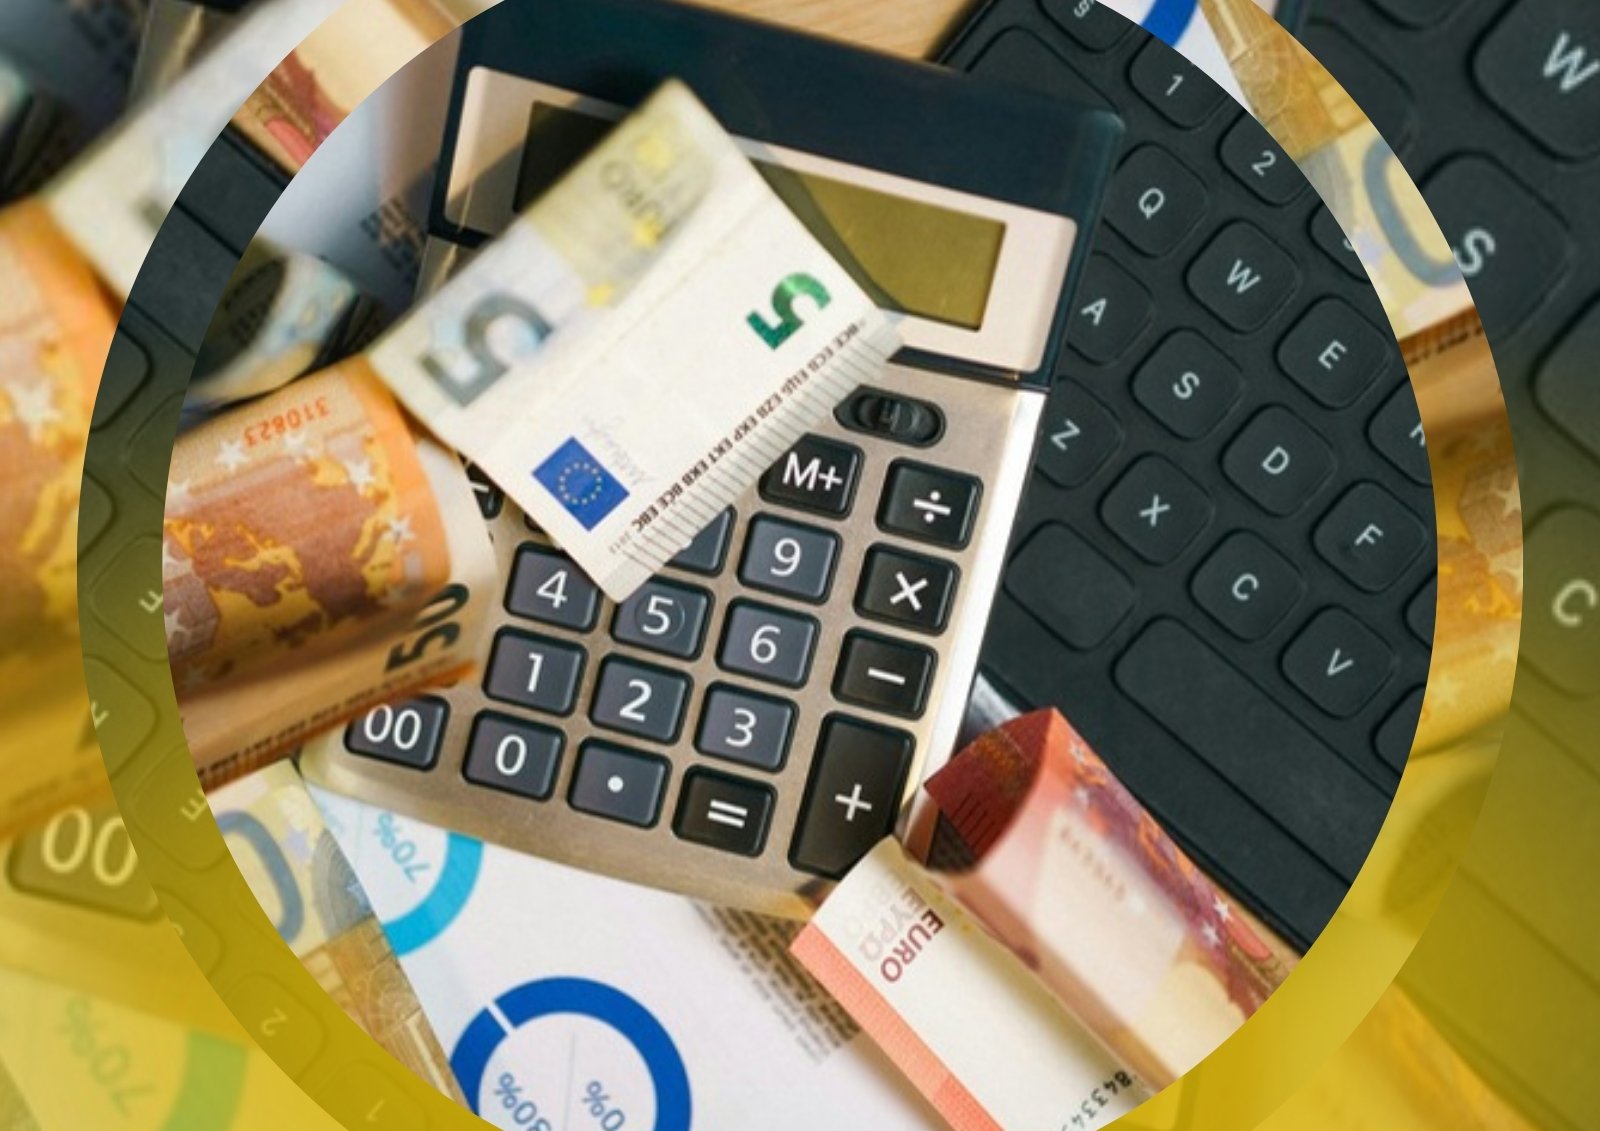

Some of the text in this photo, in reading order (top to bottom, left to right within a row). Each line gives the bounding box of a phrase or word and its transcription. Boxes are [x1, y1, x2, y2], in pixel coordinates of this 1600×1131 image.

[1543, 32, 1600, 91] W
[1166, 75, 1184, 96] 1
[1253, 151, 1276, 176] 2
[1138, 187, 1165, 219] Q
[1453, 227, 1496, 277] S
[1226, 260, 1261, 293] W
[746, 271, 832, 351] 5
[1081, 298, 1108, 325] A
[416, 289, 555, 408] 5
[1318, 340, 1347, 369] E
[1172, 371, 1200, 400] S
[1050, 419, 1081, 450] Z
[1261, 446, 1290, 475] D
[1139, 495, 1170, 526] X
[1354, 523, 1383, 548] F
[770, 537, 801, 577] 9
[536, 570, 568, 608] 4
[1231, 573, 1259, 601] C
[1551, 579, 1598, 627] C
[642, 595, 674, 635] 5
[750, 625, 781, 664] 6
[527, 652, 544, 693] 1
[1327, 649, 1354, 676] V
[619, 679, 652, 722] 2
[725, 707, 757, 747] 3
[880, 908, 945, 983] EURO
